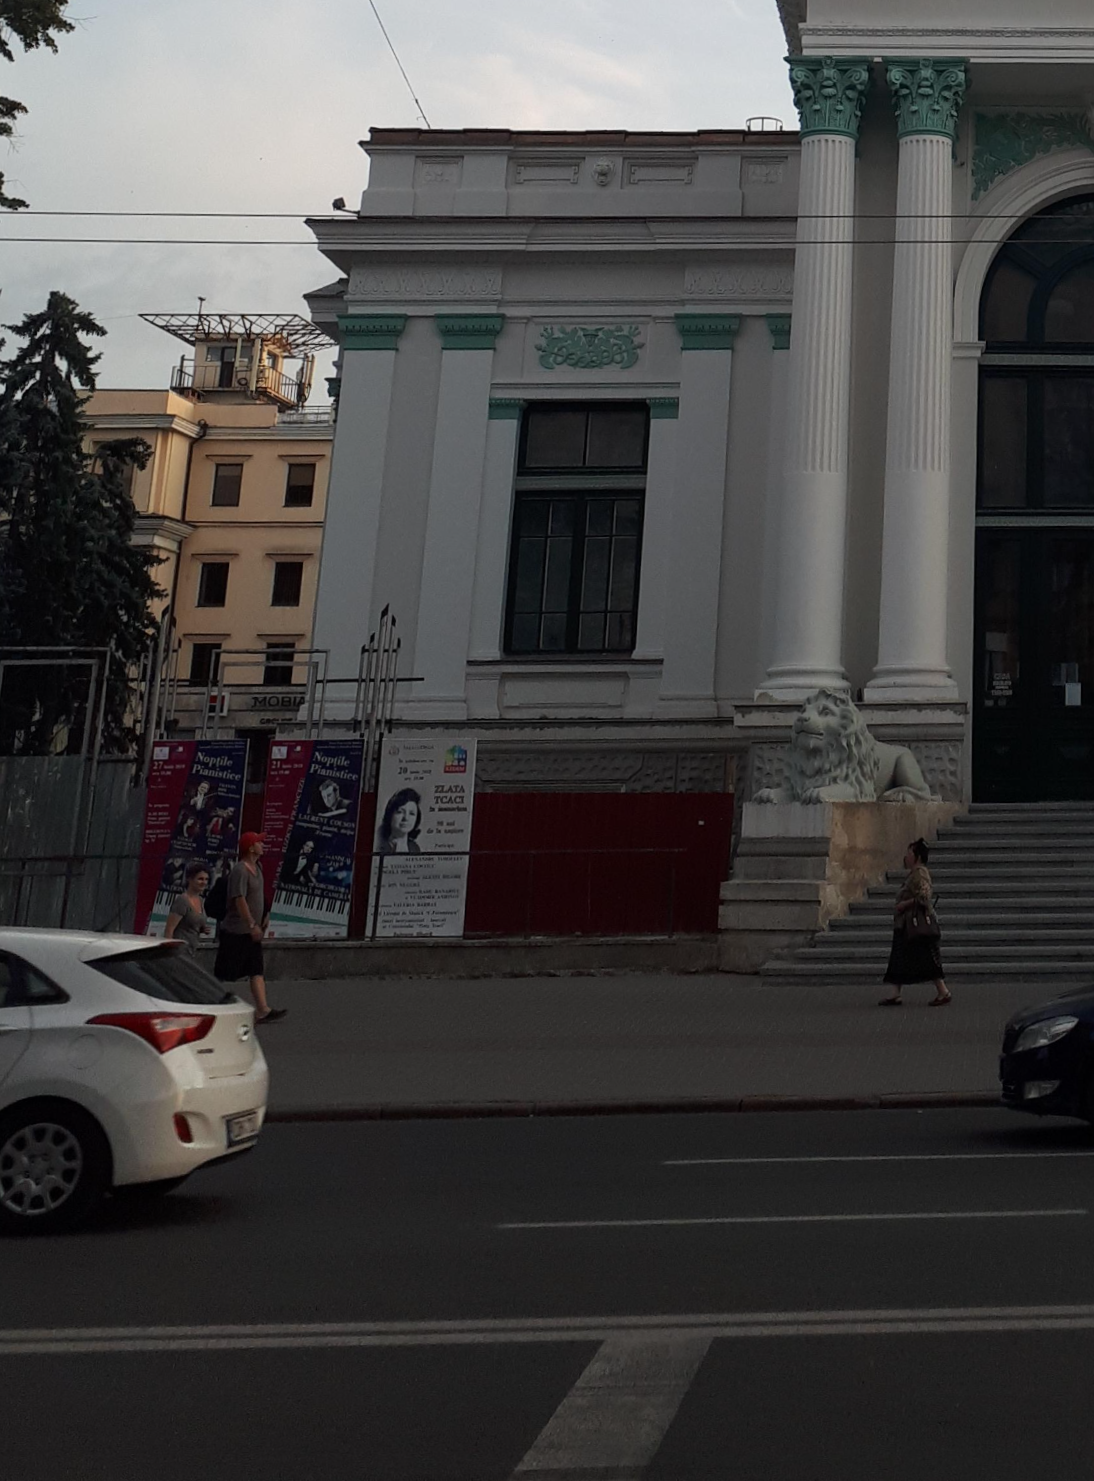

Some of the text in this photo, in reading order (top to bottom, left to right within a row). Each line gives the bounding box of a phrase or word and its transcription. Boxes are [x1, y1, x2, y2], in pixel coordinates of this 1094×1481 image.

[192, 763, 242, 781] Pianistice
[309, 763, 359, 781] Pianistice
[434, 785, 465, 794] ZLATA
[434, 796, 465, 804] TCACI
